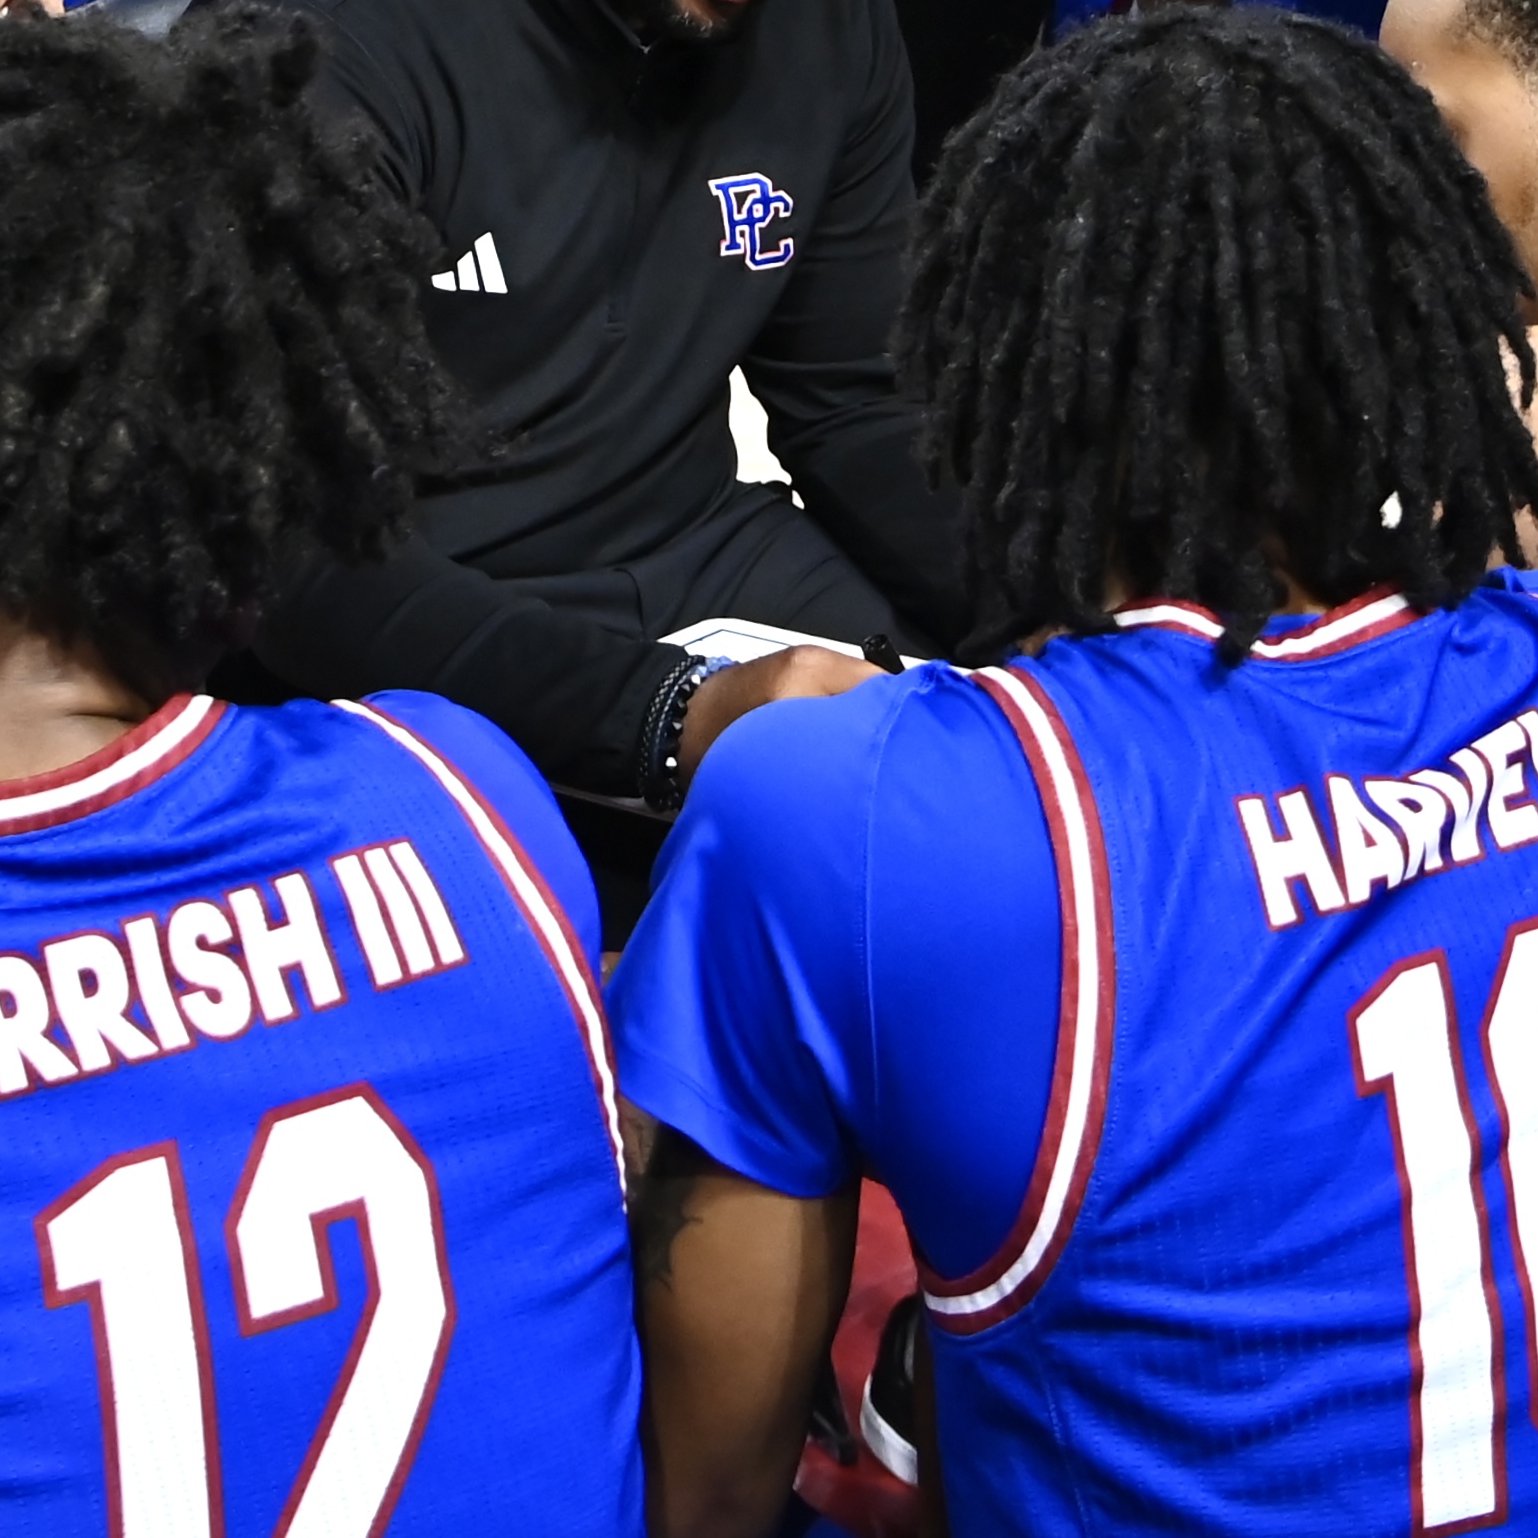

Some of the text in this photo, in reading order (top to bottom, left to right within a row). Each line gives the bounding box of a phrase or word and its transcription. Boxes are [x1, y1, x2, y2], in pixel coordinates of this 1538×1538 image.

[708, 172, 794, 271] PC
[329, 837, 469, 992] III
[33, 1081, 456, 1538] 12
